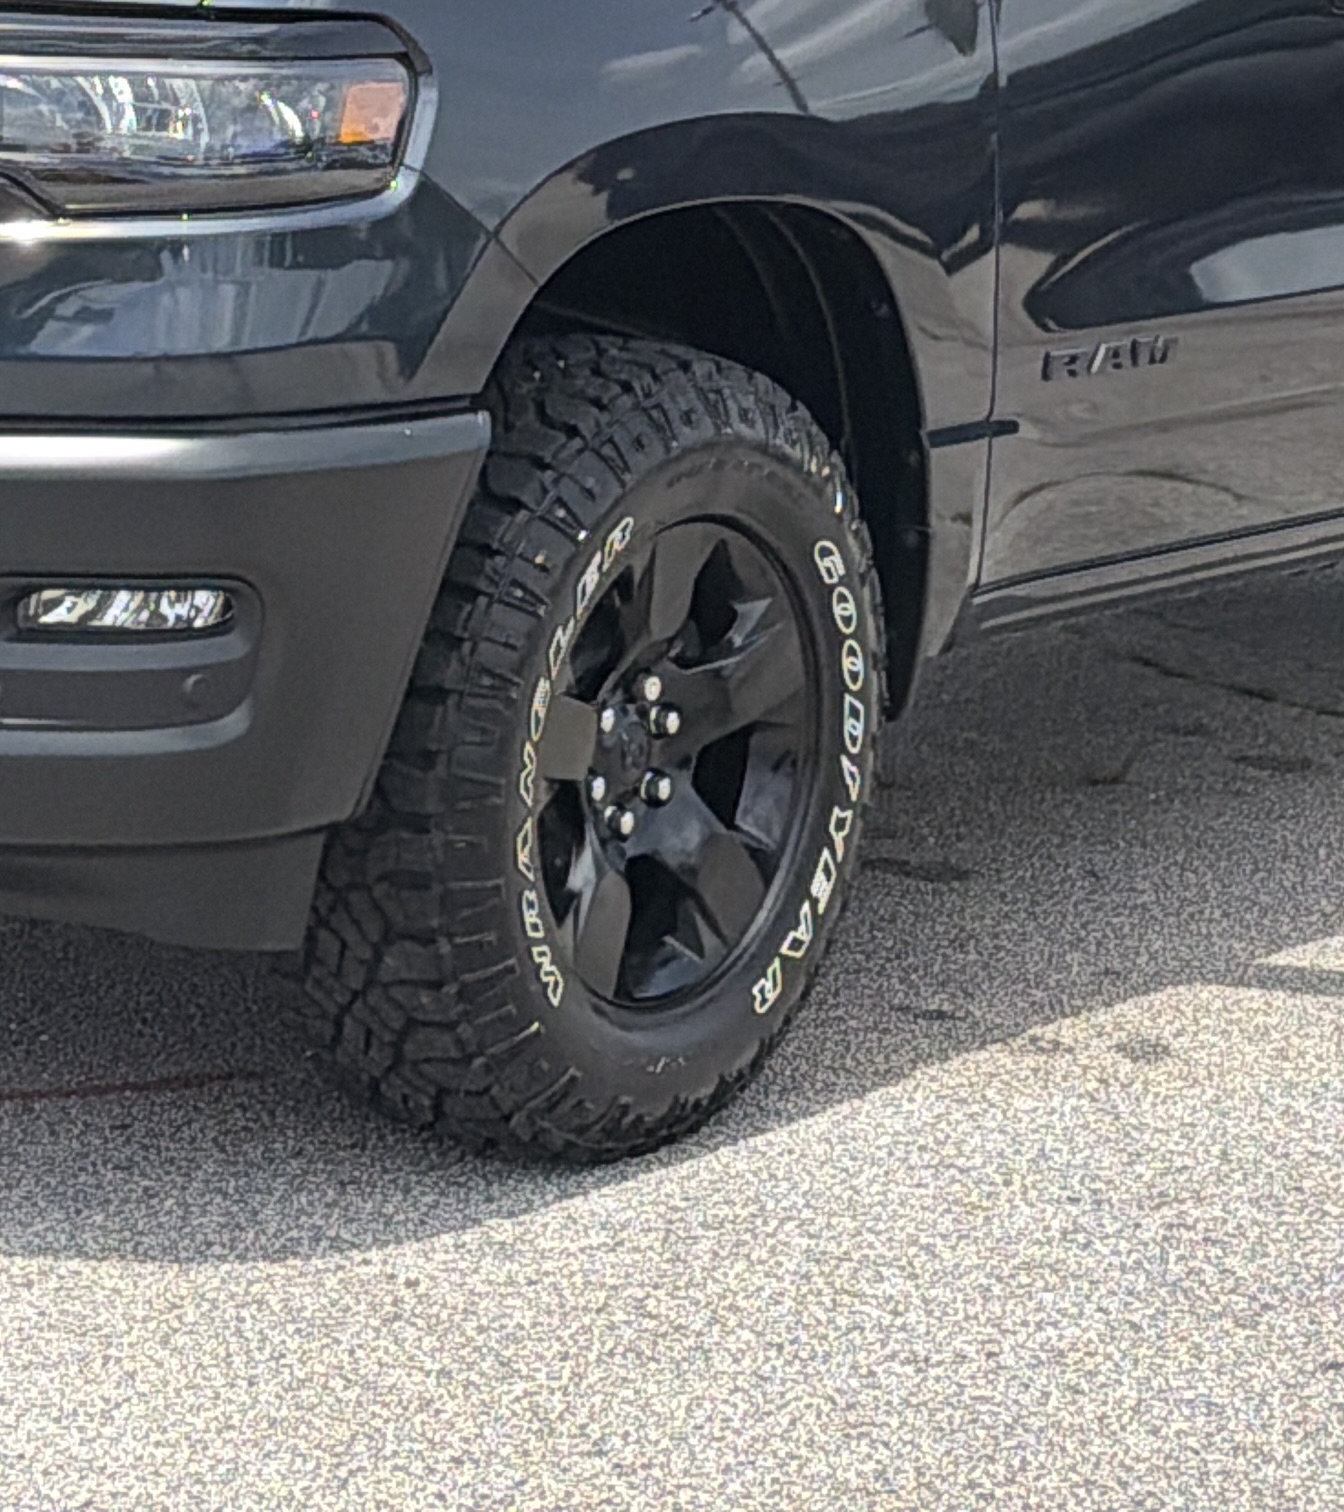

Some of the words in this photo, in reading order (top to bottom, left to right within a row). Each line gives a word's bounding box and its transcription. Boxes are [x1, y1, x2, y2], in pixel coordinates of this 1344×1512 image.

[1041, 335, 1178, 382] RAM
[516, 516, 635, 1007] WRANGLER
[753, 540, 865, 1014] GOODYEAR
